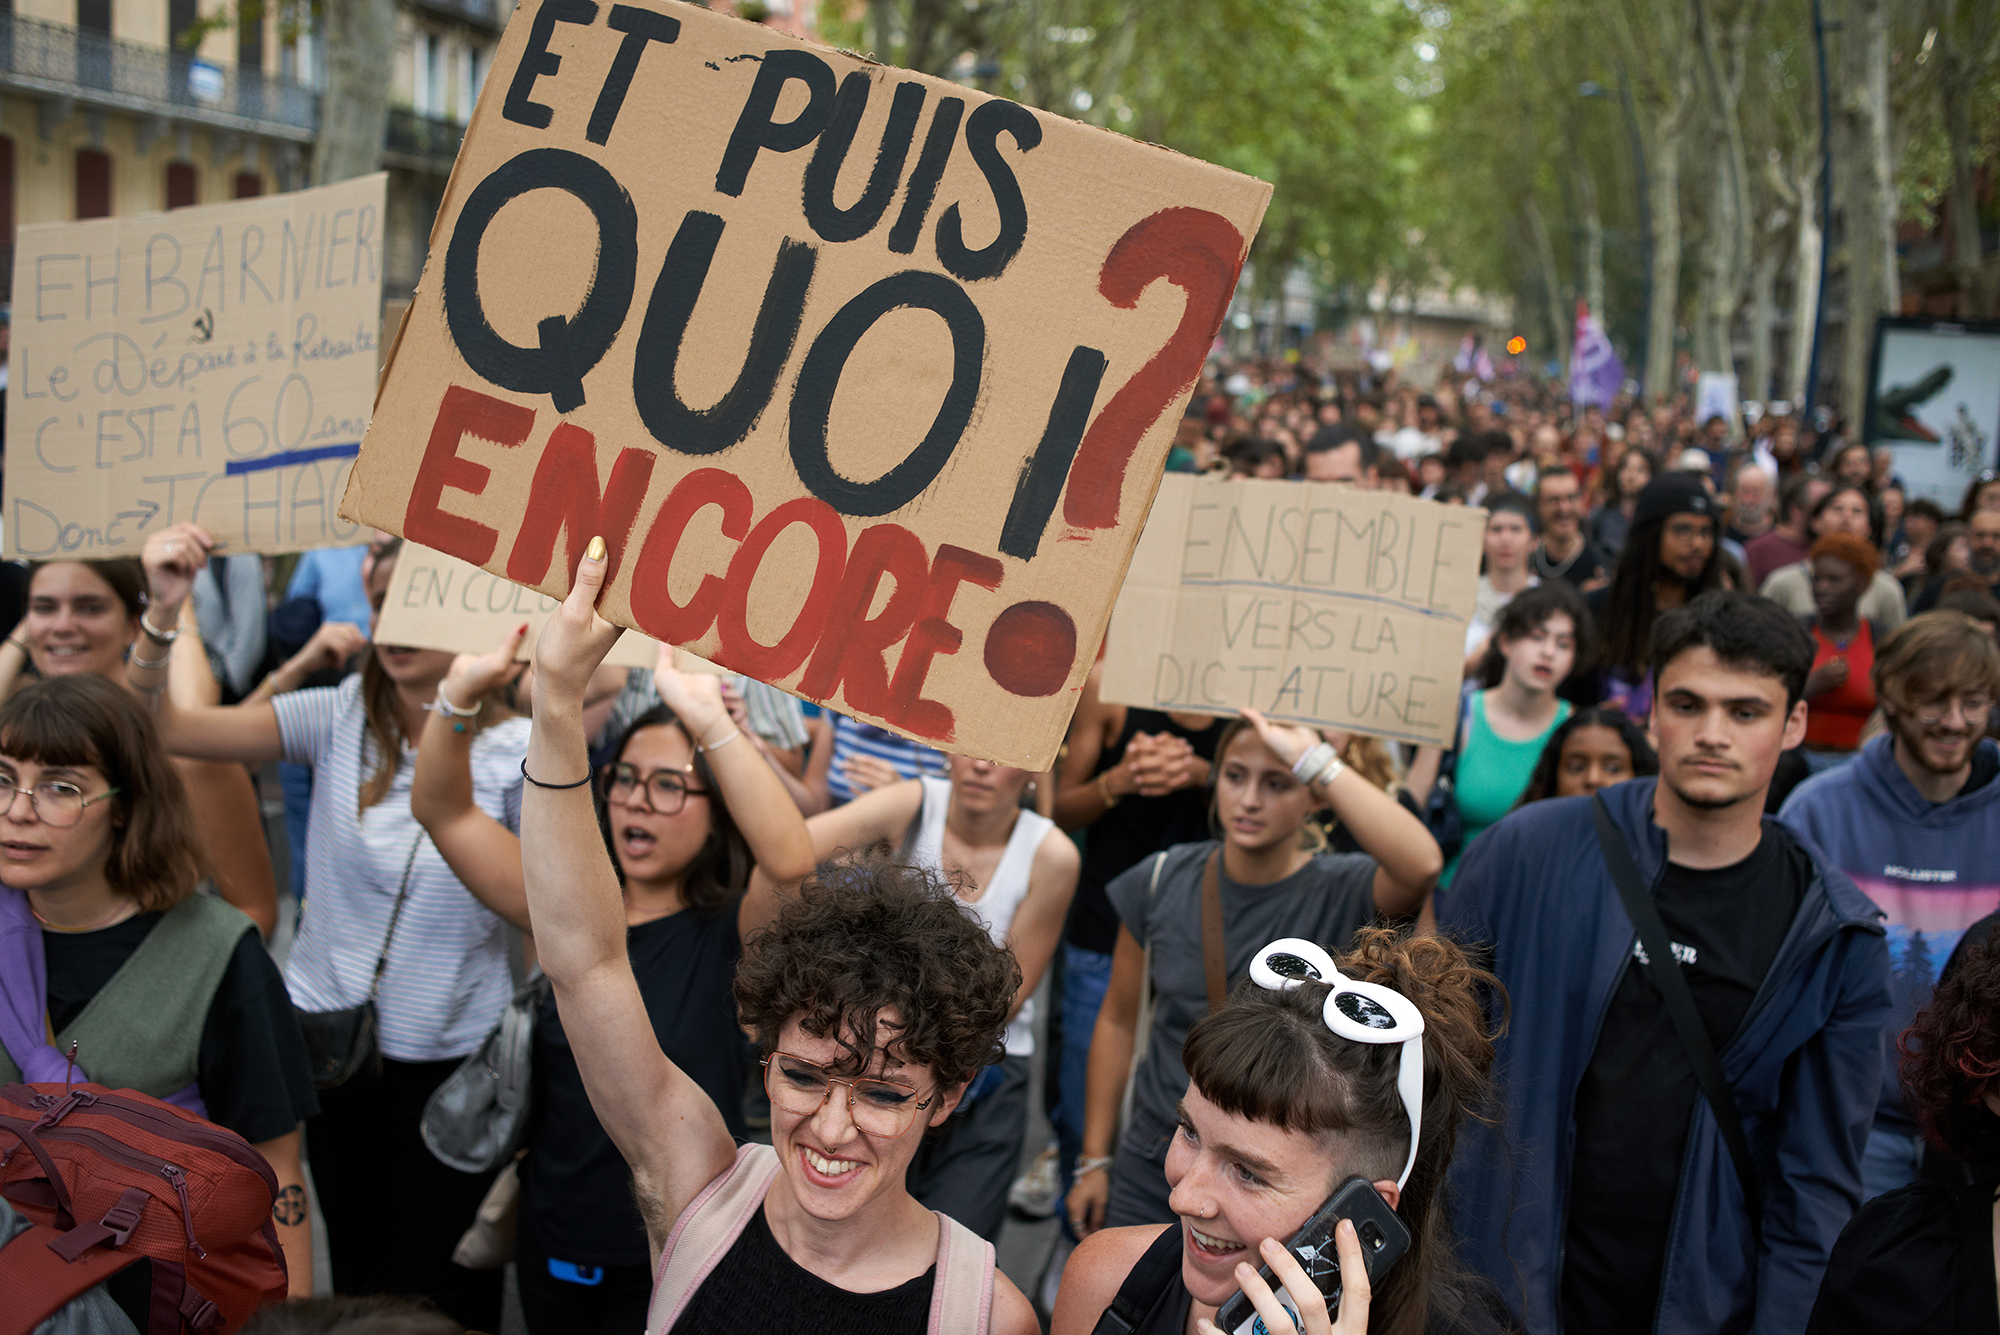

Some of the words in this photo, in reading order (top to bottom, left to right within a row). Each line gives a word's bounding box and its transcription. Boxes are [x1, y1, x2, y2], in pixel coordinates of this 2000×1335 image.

[502, 0, 682, 146] ET
[714, 49, 1043, 283] PUIS
[35, 246, 121, 322] EH
[139, 203, 378, 325] BARNIER
[22, 346, 80, 401] Le
[243, 338, 259, 365] à
[266, 329, 287, 363] la
[443, 147, 1109, 562] QUOI
[35, 404, 176, 473] C'EST
[222, 372, 315, 460] 60
[13, 497, 126, 557] Donc
[403, 384, 1004, 743] ENCORE
[1181, 503, 1463, 608] ENSEMBLE
[403, 566, 454, 609] EN
[1221, 596, 1337, 652] VERS
[1351, 614, 1400, 654] LA
[1154, 652, 1440, 730] DICTATURE
